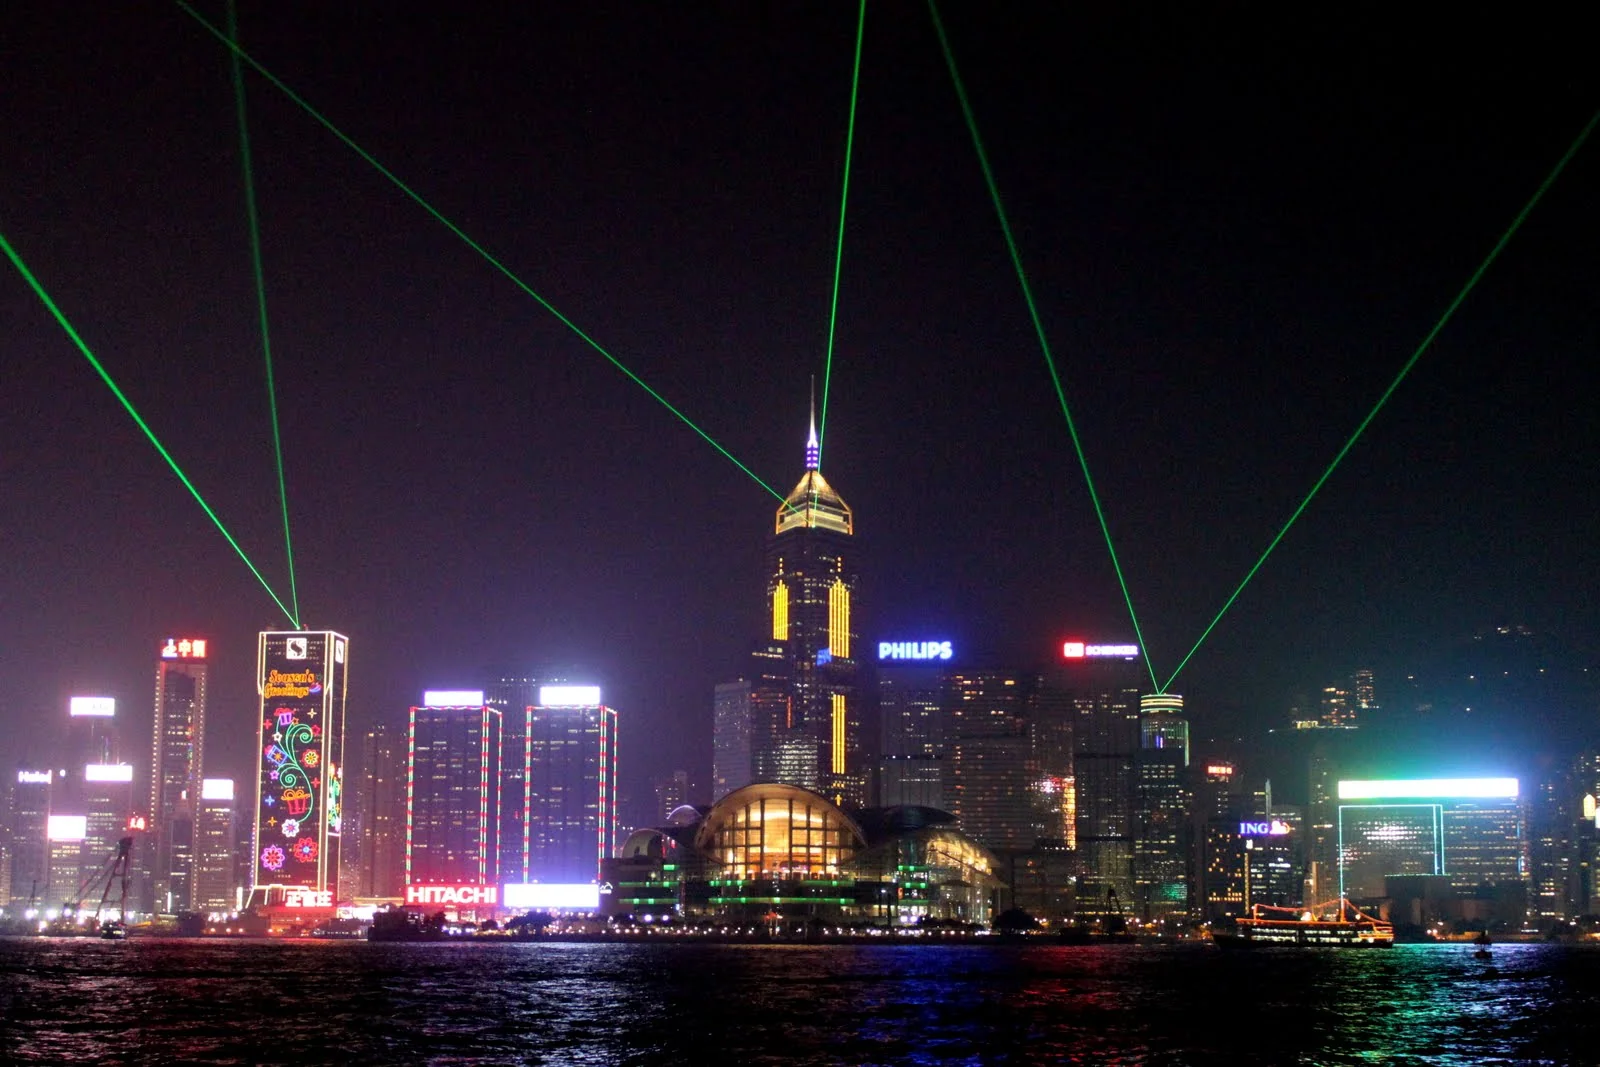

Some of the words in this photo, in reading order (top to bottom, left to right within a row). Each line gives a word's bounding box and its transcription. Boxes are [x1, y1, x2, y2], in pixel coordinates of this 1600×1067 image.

[879, 641, 953, 660] PHILIPS
[269, 669, 315, 683] Season's
[265, 683, 309, 698] Greetings
[1240, 822, 1269, 834] ING
[407, 886, 497, 904] HITACHI
